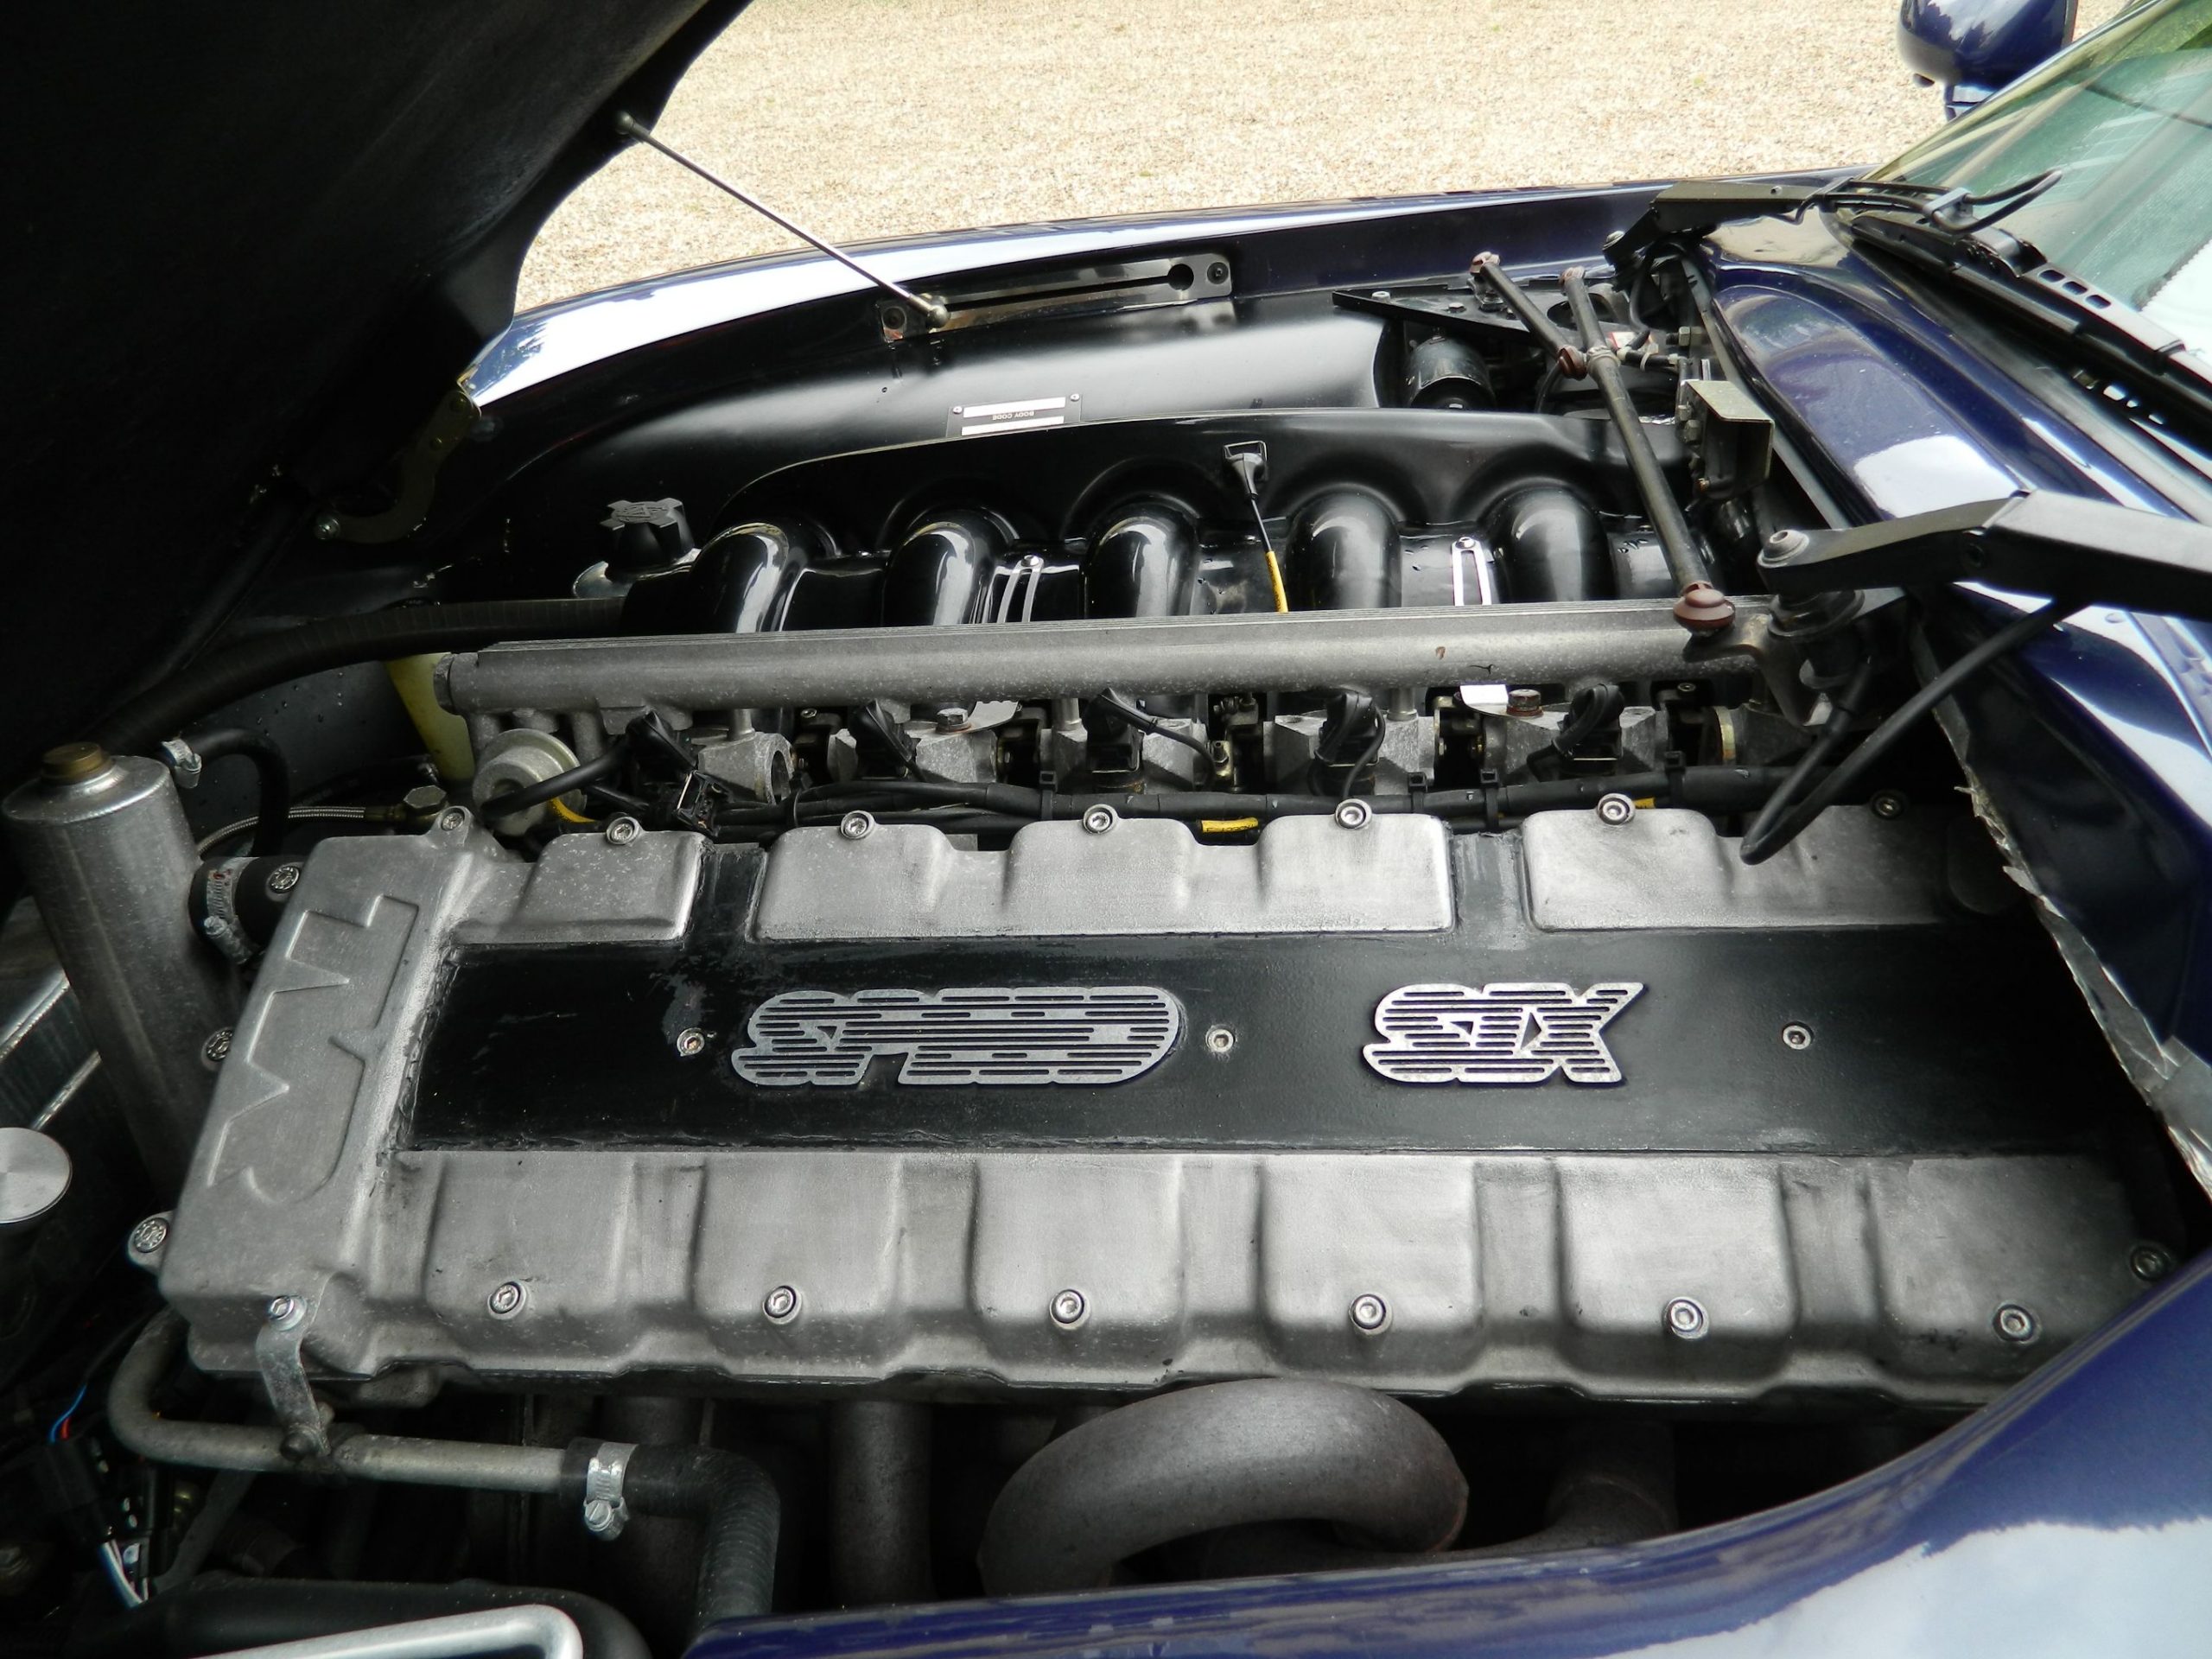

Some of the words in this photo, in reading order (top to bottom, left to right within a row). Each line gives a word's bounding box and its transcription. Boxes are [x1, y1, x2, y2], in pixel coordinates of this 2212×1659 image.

[207, 895, 419, 1204] TVR
[731, 987, 1181, 1086] SPEED
[1363, 982, 1645, 1084] SIX
